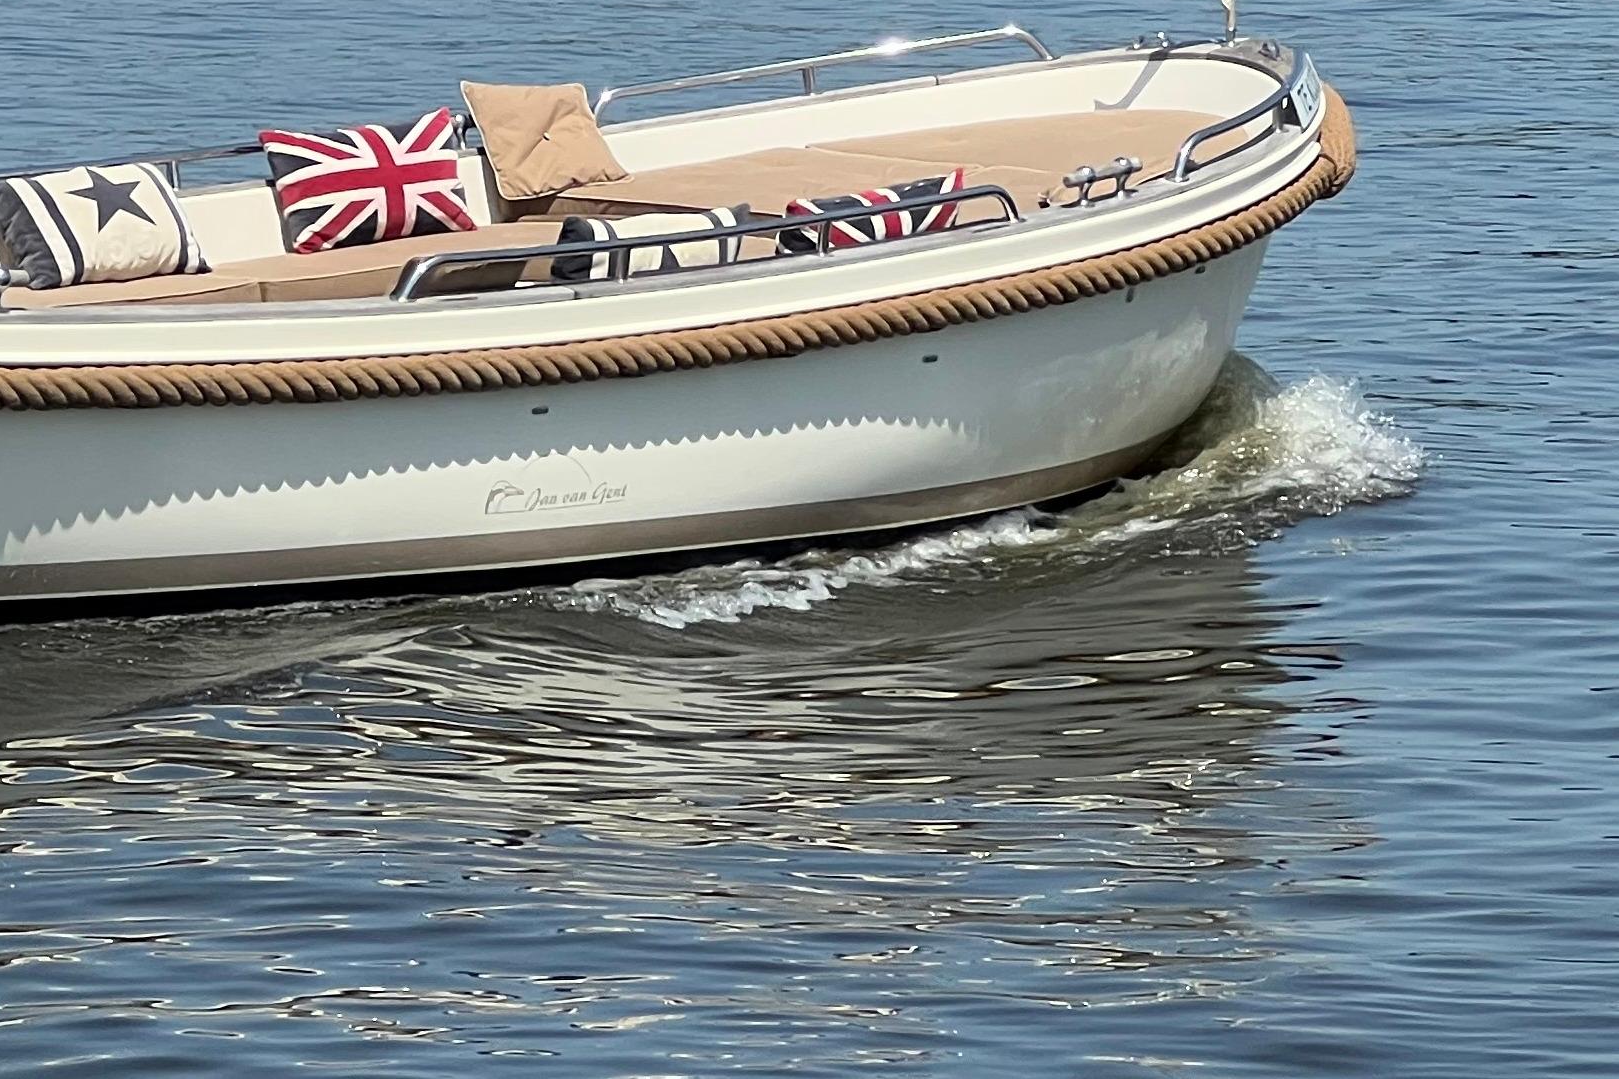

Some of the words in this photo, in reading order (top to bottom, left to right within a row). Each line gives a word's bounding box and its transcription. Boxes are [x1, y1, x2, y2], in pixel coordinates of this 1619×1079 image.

[524, 487, 558, 512] Jan
[562, 491, 587, 504] van
[592, 481, 628, 504] Gent
